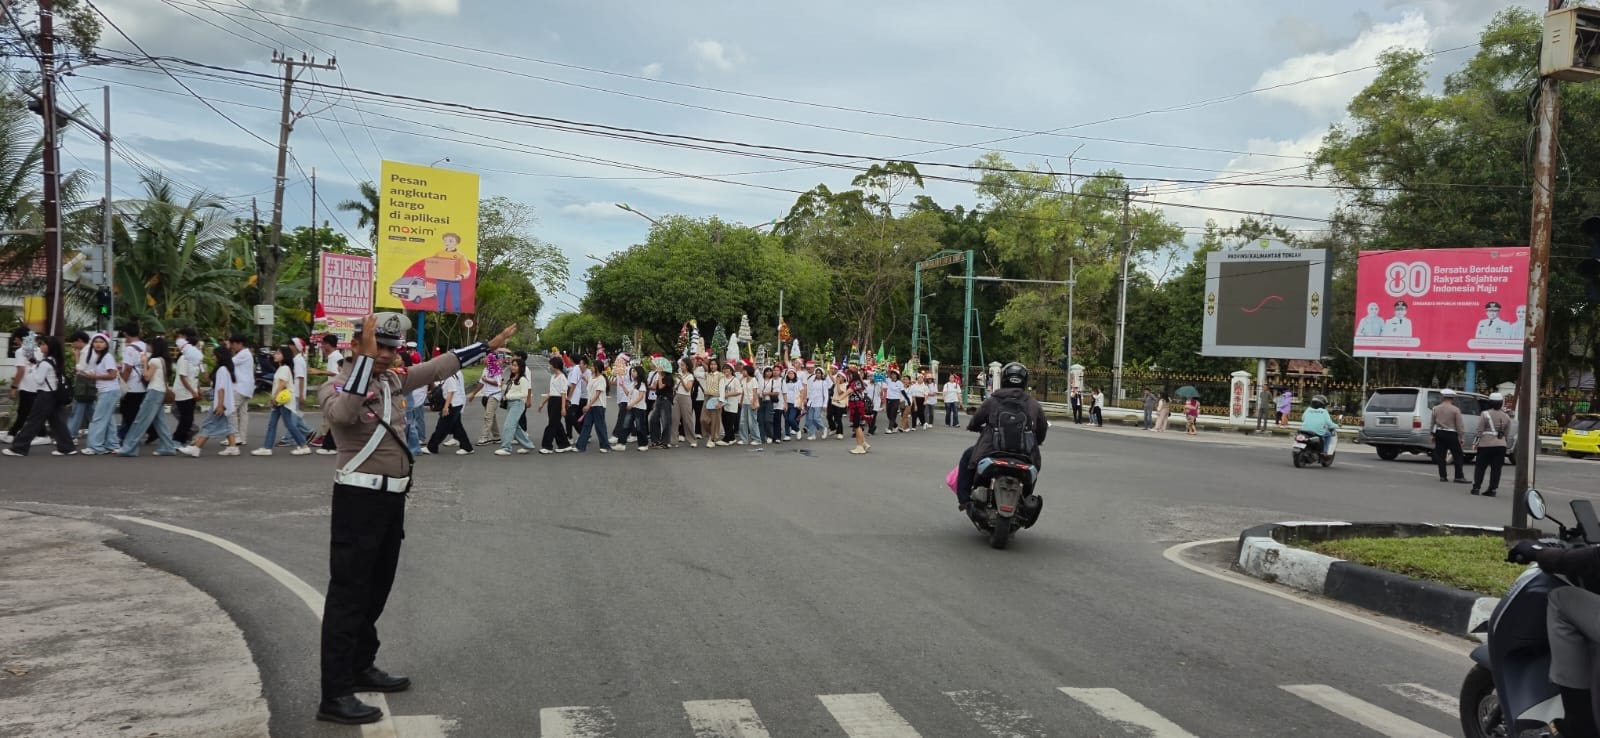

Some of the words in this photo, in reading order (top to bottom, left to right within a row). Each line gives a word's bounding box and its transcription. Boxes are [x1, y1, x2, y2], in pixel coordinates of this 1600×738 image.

[391, 174, 428, 186] Pesan
[390, 188, 447, 200] angkutan
[390, 198, 424, 211] kargo
[389, 211, 400, 220] di
[404, 214, 450, 226] aplikasi
[388, 225, 434, 236] maxim
[327, 258, 342, 276] #1
[344, 259, 370, 272] PUSAT
[1434, 265, 1468, 274] Bersatu
[1470, 264, 1513, 273] Berdaulat
[1385, 261, 1431, 298] 80
[1433, 275, 1464, 284] Rakyat
[1464, 274, 1508, 284] Sejahtera
[325, 278, 370, 298] BAHAN
[1432, 285, 1475, 293] Indonesia
[1476, 284, 1498, 294] Maju
[324, 296, 369, 309] BANGUNAN
